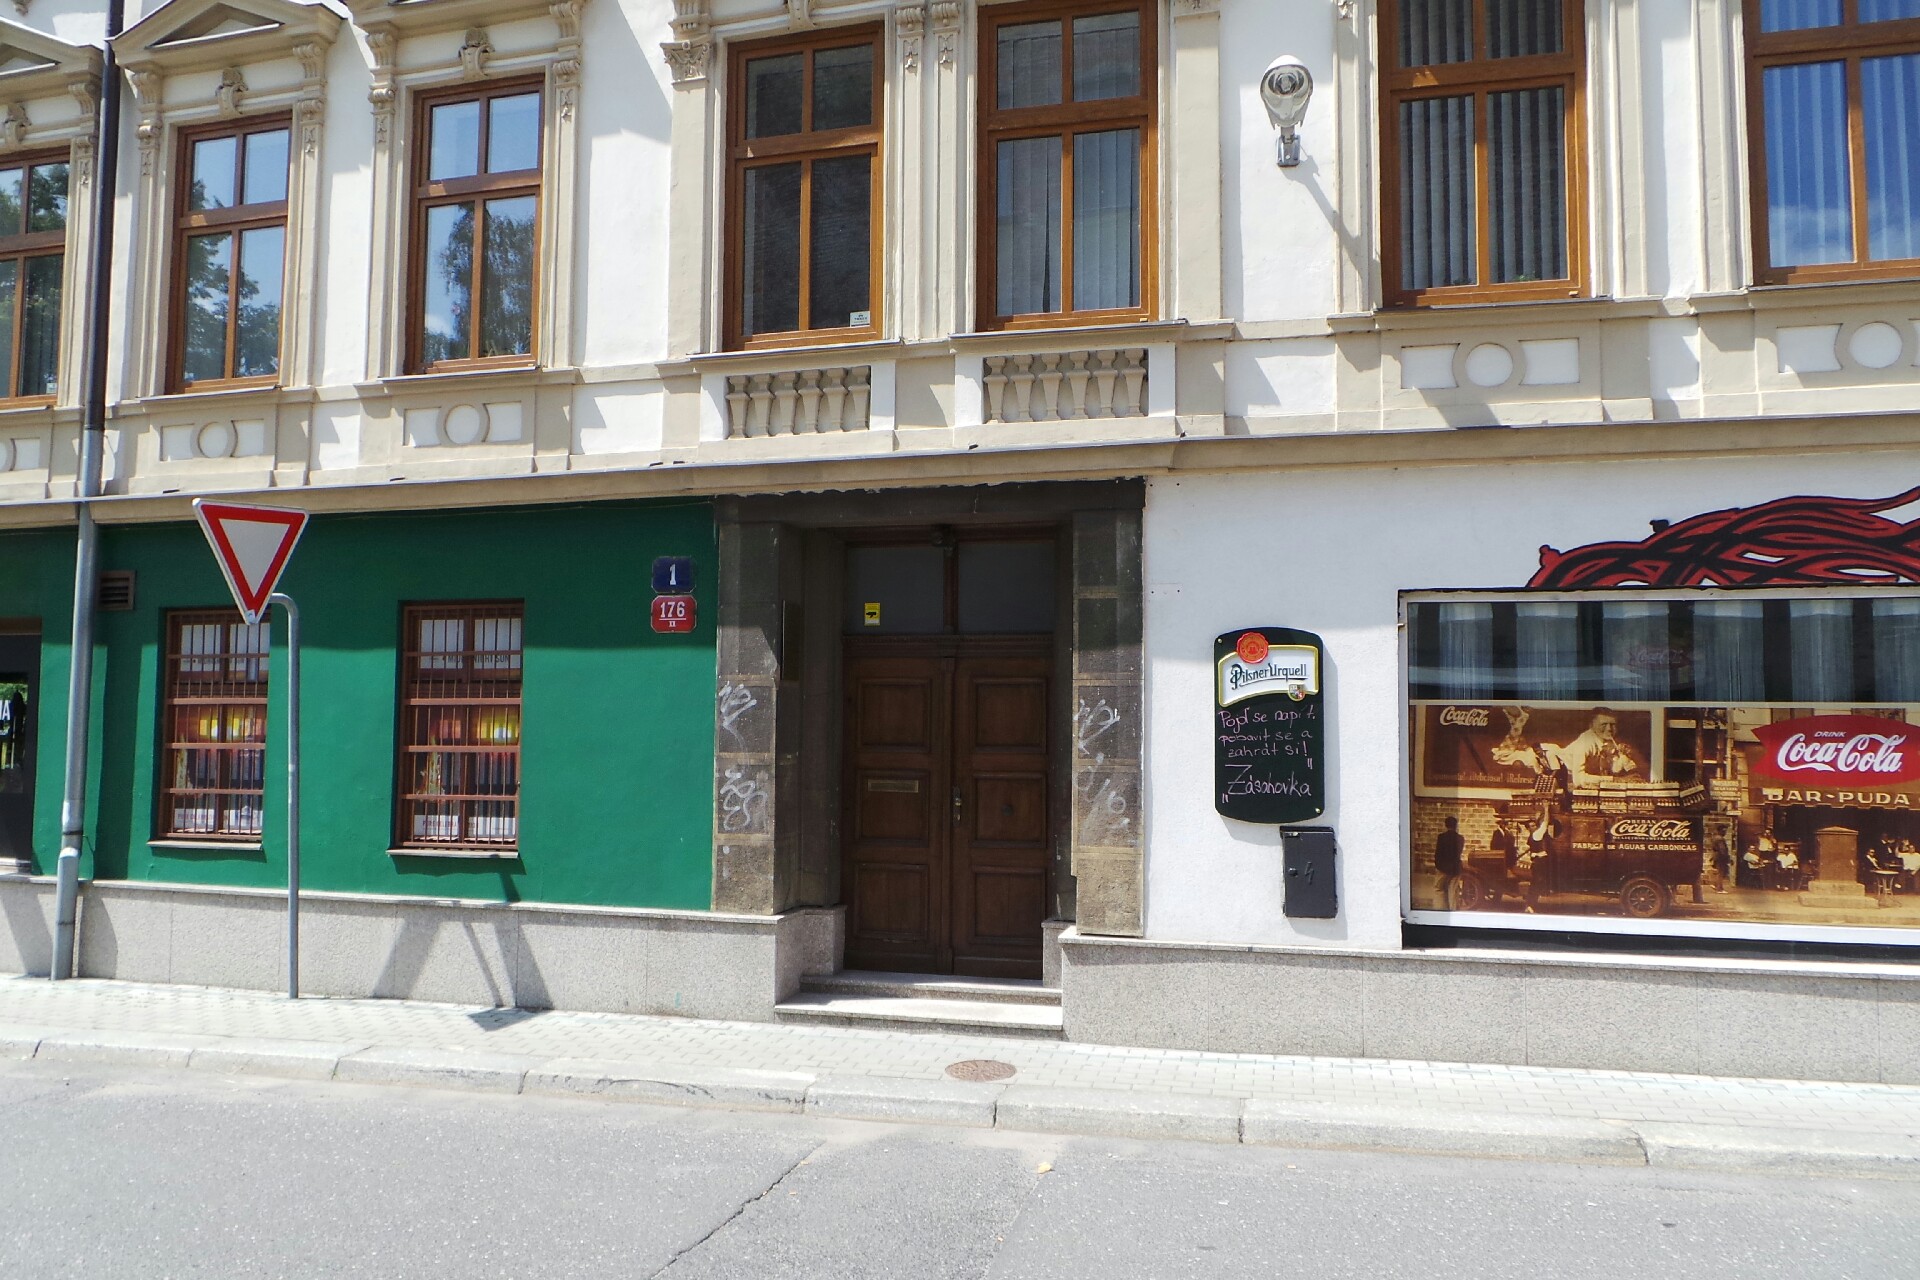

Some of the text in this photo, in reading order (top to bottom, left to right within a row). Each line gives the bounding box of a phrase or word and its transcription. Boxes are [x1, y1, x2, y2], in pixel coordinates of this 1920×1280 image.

[669, 563, 677, 586] 1
[660, 601, 686, 618] 176
[1230, 663, 1307, 690] Pilsner Urquell
[1253, 712, 1268, 722] se
[1275, 732, 1293, 741] se
[1301, 730, 1313, 739] a
[1777, 733, 1907, 773] Coca-Cola
[1610, 819, 1692, 838] Coca-Cola
[1572, 842, 1604, 850] FABRICA
[1618, 843, 1646, 851] AGUAS
